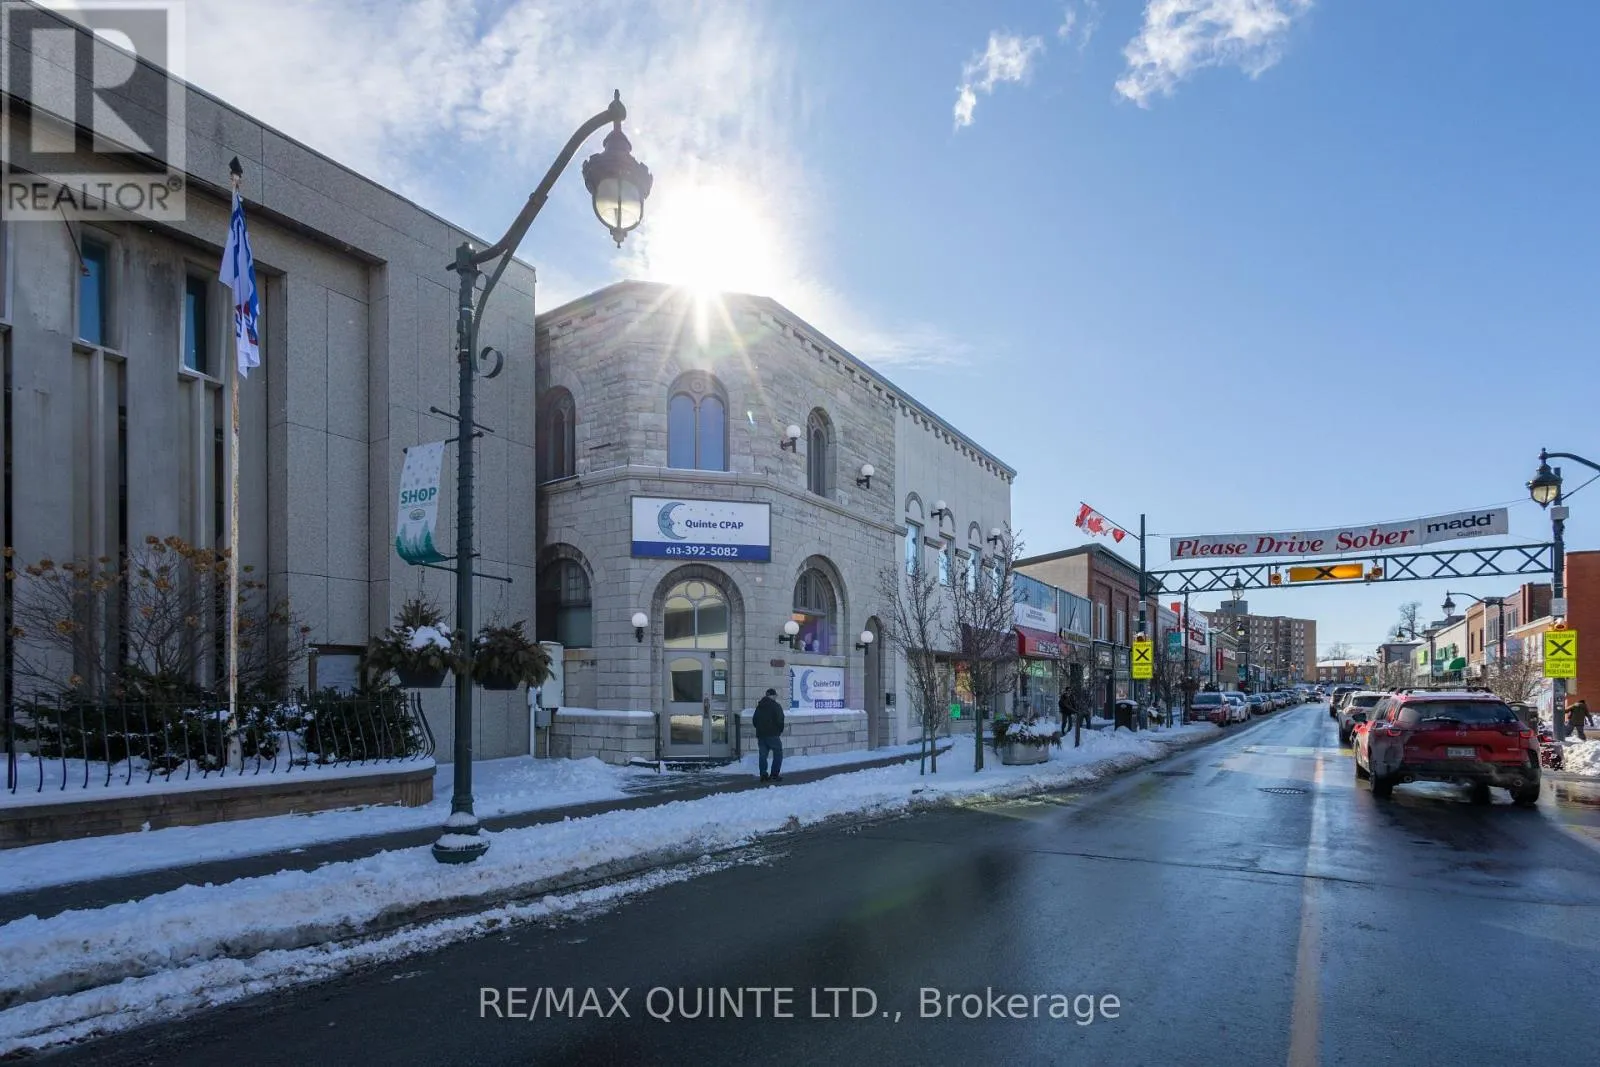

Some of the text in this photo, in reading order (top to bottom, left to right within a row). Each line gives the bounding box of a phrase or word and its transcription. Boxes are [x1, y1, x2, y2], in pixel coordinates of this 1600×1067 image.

[401, 487, 437, 504] SHOP
[685, 519, 744, 530] Quinte CPAP
[1176, 528, 1415, 557] Please Drive Sober
[666, 545, 738, 557] 613-392-5082
